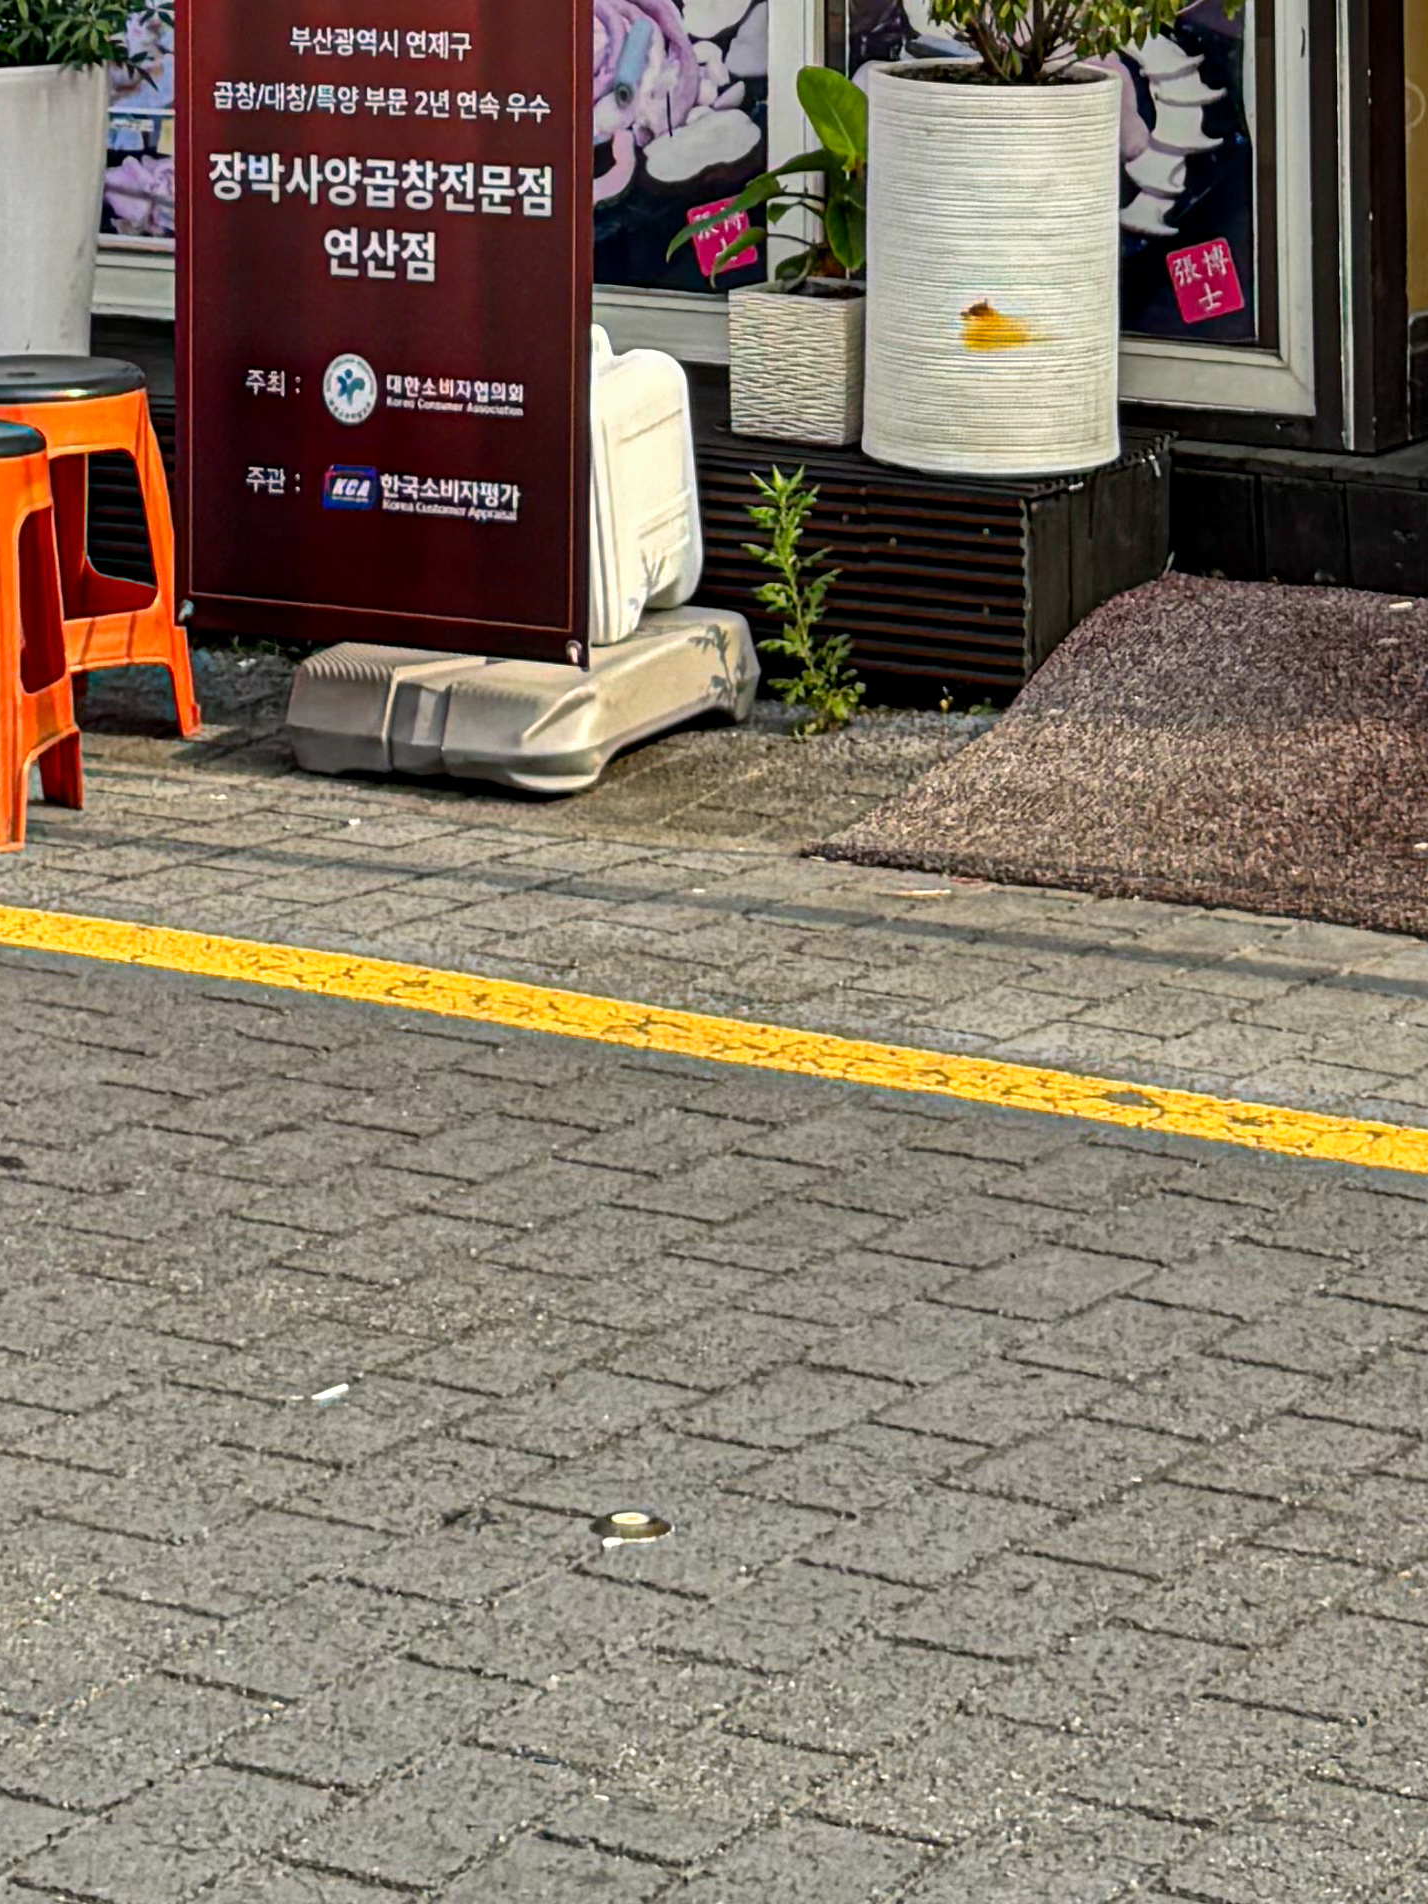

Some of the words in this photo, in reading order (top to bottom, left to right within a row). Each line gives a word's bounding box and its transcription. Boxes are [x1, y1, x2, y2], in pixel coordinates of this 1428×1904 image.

[290, 27, 399, 58] 부산광역시
[406, 31, 472, 62] 연제구
[364, 86, 408, 117] 부문
[415, 89, 449, 119] 2년
[456, 91, 500, 121] 연속
[506, 93, 551, 123] 우수
[209, 151, 553, 217] 장박사양곱창전문점
[324, 227, 436, 283] 연산점
[380, 474, 521, 509] 한국소비자평가
